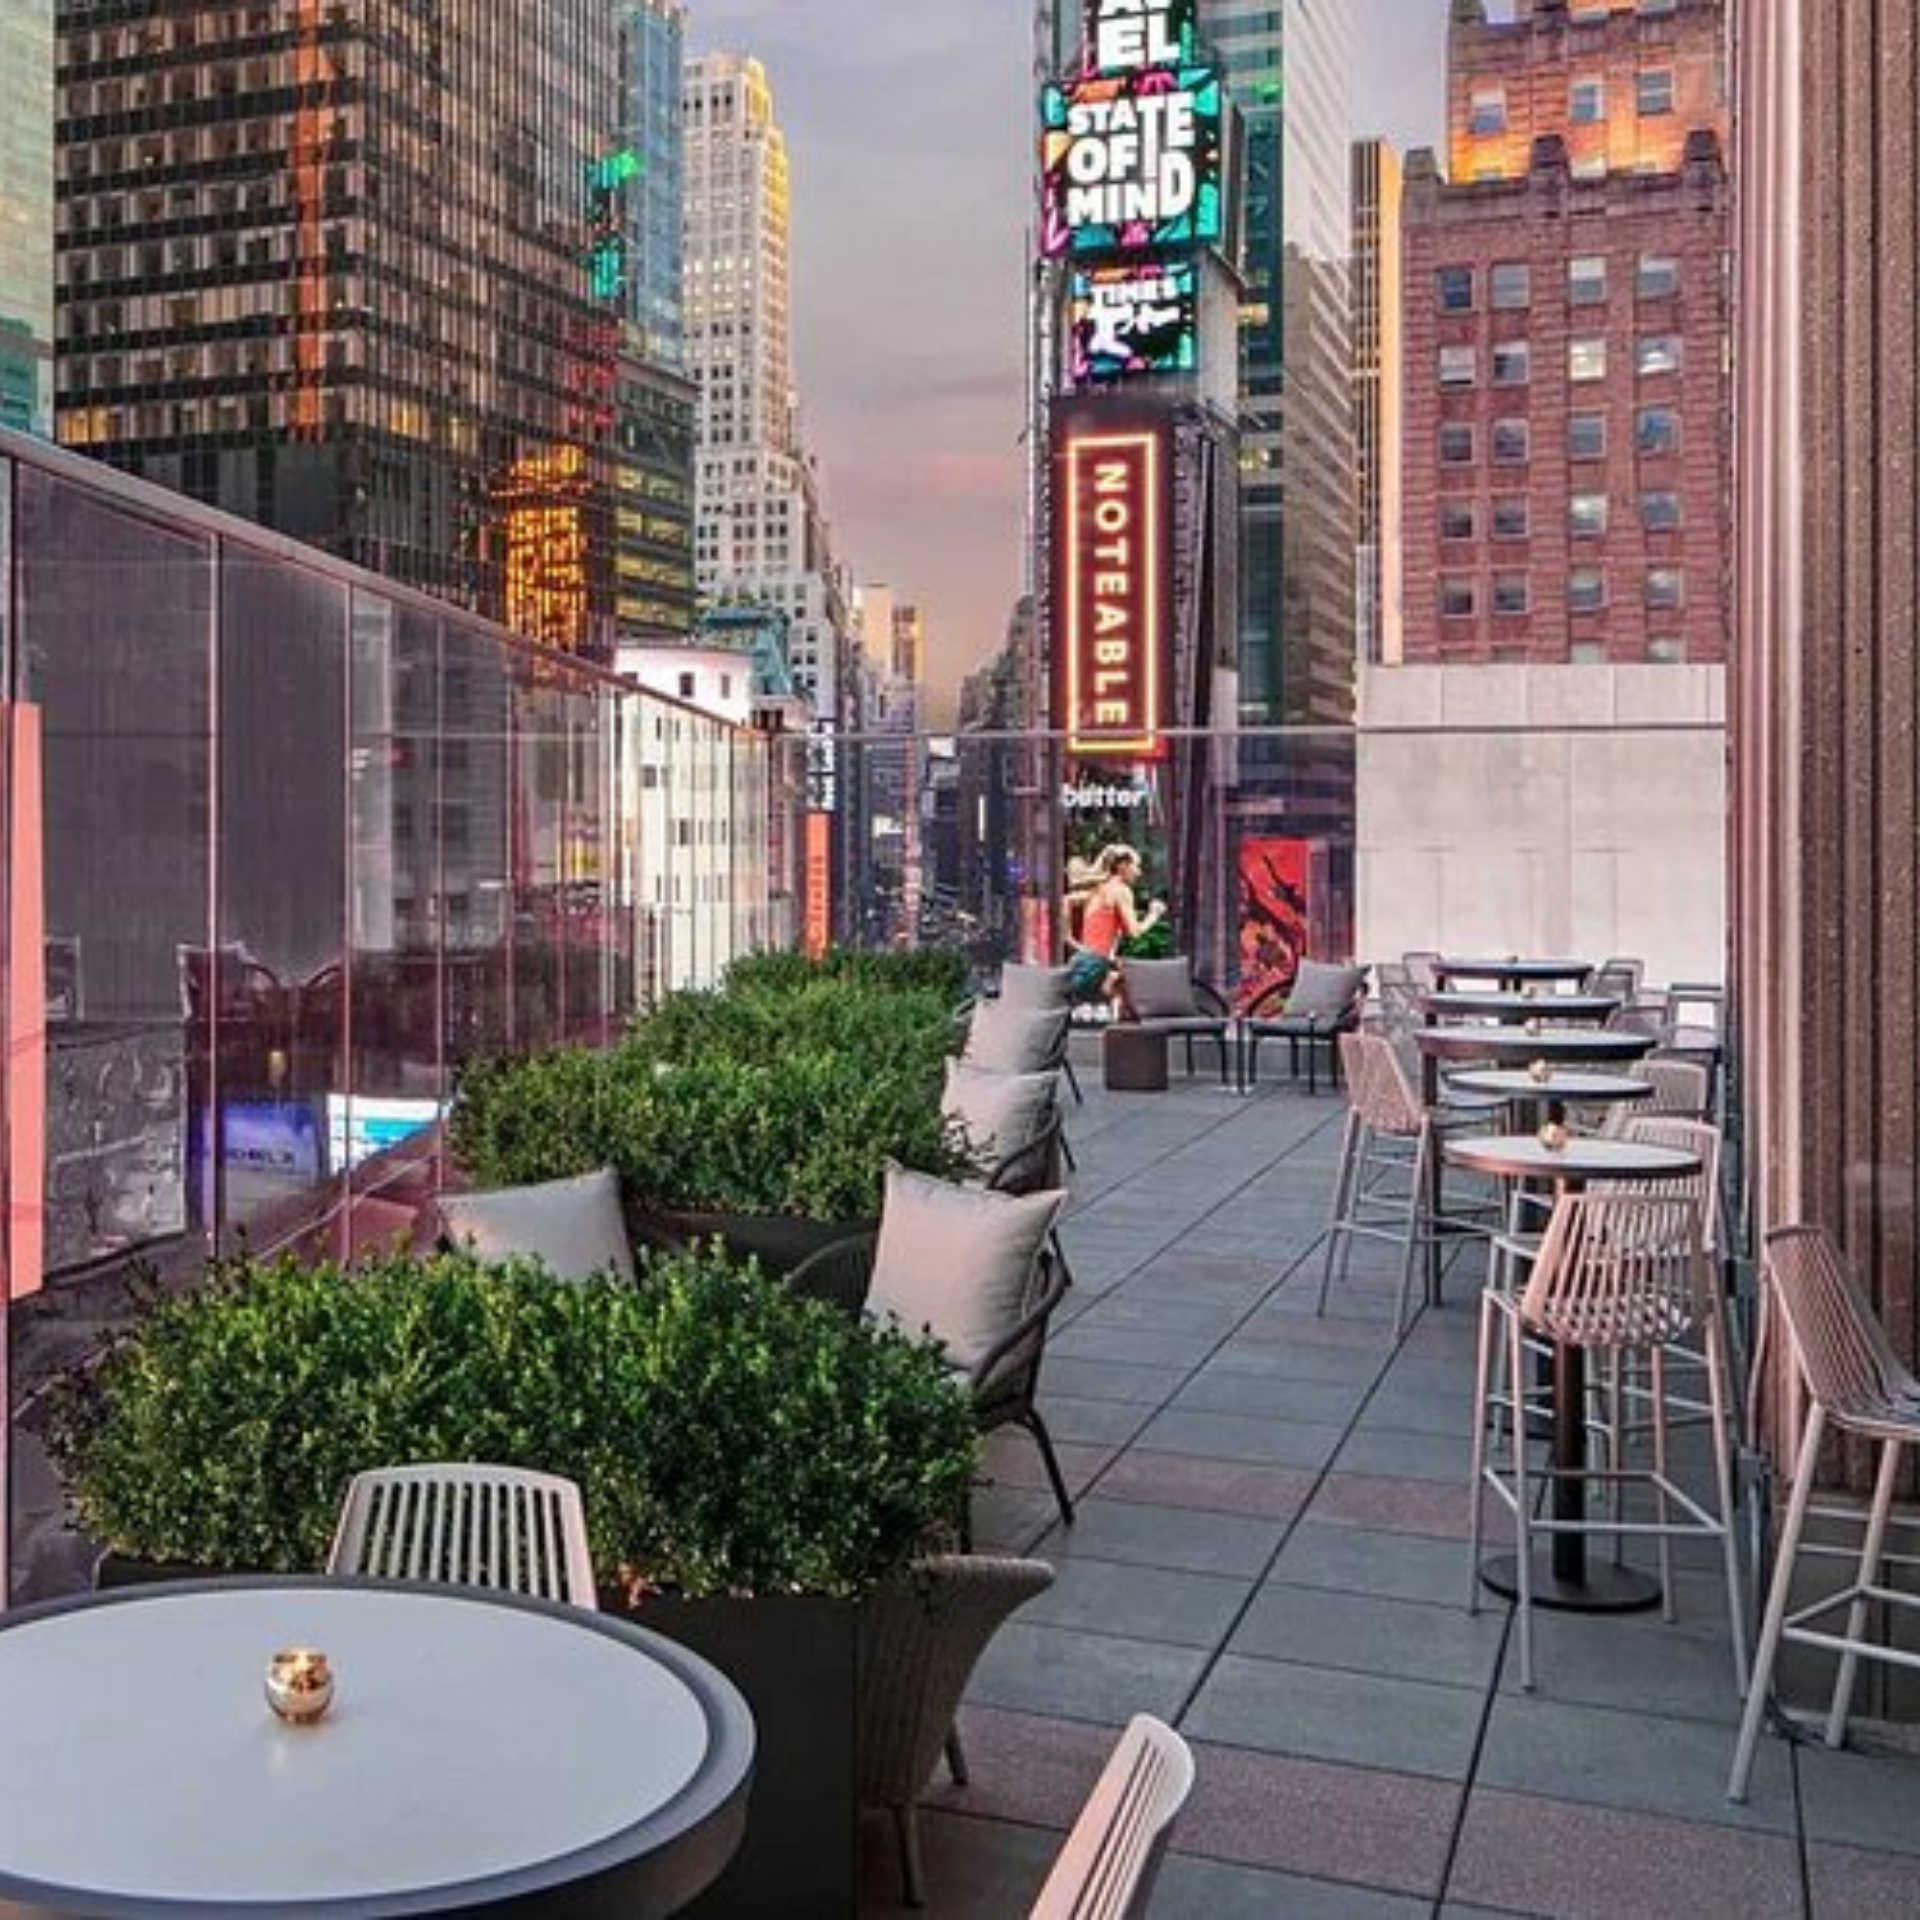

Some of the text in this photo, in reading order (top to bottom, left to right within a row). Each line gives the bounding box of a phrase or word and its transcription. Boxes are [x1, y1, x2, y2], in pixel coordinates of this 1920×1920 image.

[1098, 13, 1180, 68] EL
[1067, 91, 1195, 178] STATE
[1067, 134, 1139, 183] OF
[1067, 150, 1195, 227] MIND
[1094, 462, 1129, 726] NOTEABLE
